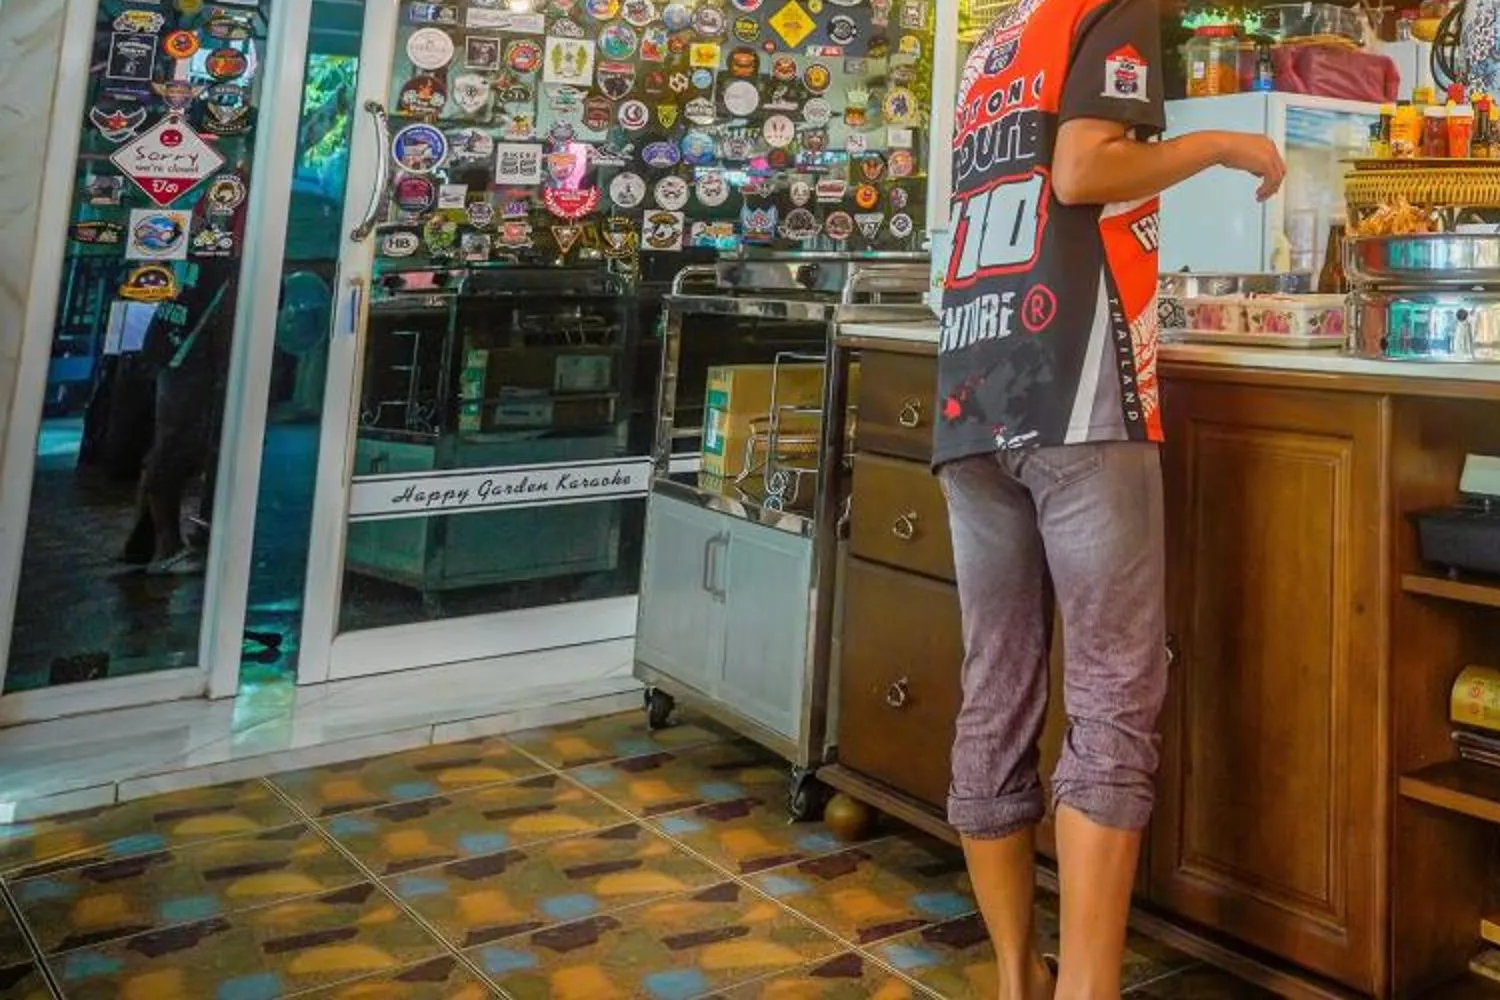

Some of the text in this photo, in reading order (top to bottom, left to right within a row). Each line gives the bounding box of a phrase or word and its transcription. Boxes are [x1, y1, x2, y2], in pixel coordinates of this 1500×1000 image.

[135, 145, 199, 167] Sorry
[1108, 296, 1141, 422] THAILAND
[391, 468, 632, 508] Happy Garden Karaoke
